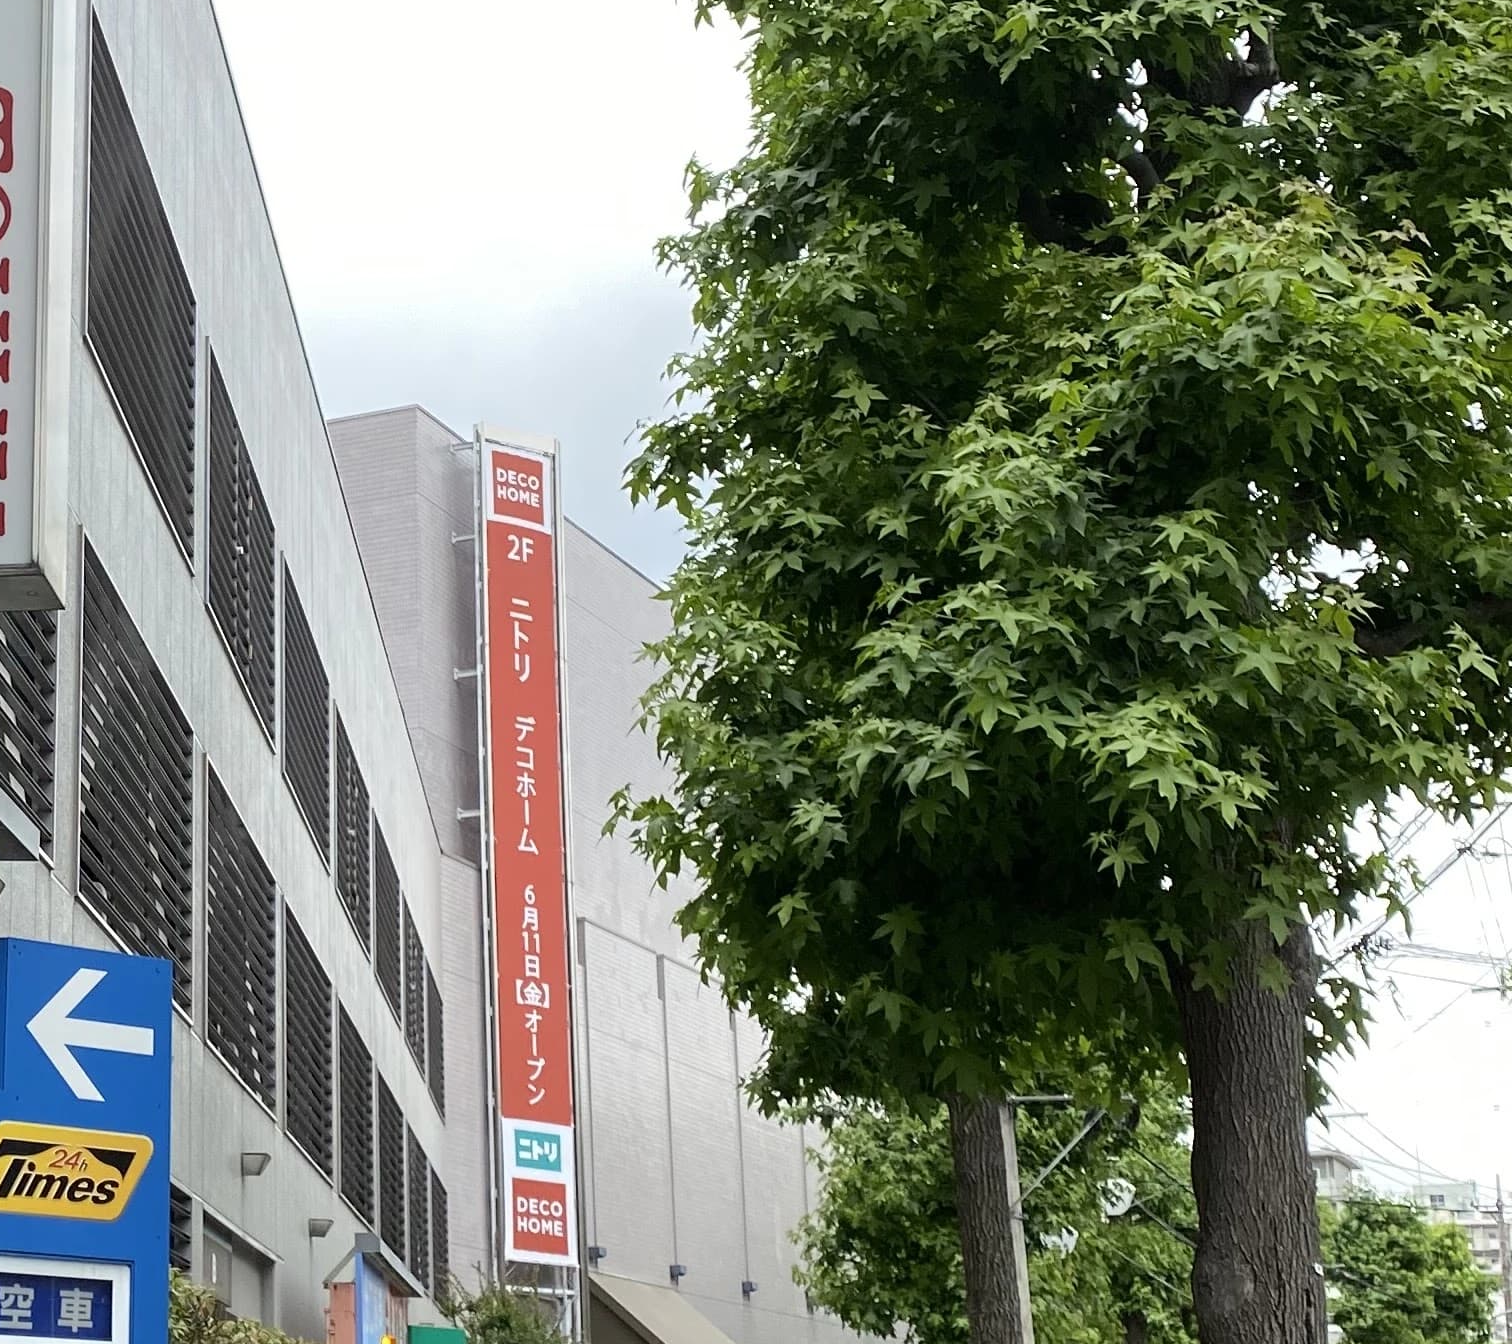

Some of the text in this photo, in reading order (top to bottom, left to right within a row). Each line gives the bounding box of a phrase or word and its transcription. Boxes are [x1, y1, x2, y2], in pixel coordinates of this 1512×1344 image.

[496, 466, 540, 491] DECO
[496, 486, 541, 508] HOME
[507, 534, 534, 563] 2F
[509, 597, 534, 682] ニトリ
[514, 716, 539, 856] デコホーム
[49, 1149, 88, 1171] 24h
[519, 1138, 558, 1162] ニトリ
[516, 1196, 564, 1217] DECO
[517, 1215, 564, 1237] HOME
